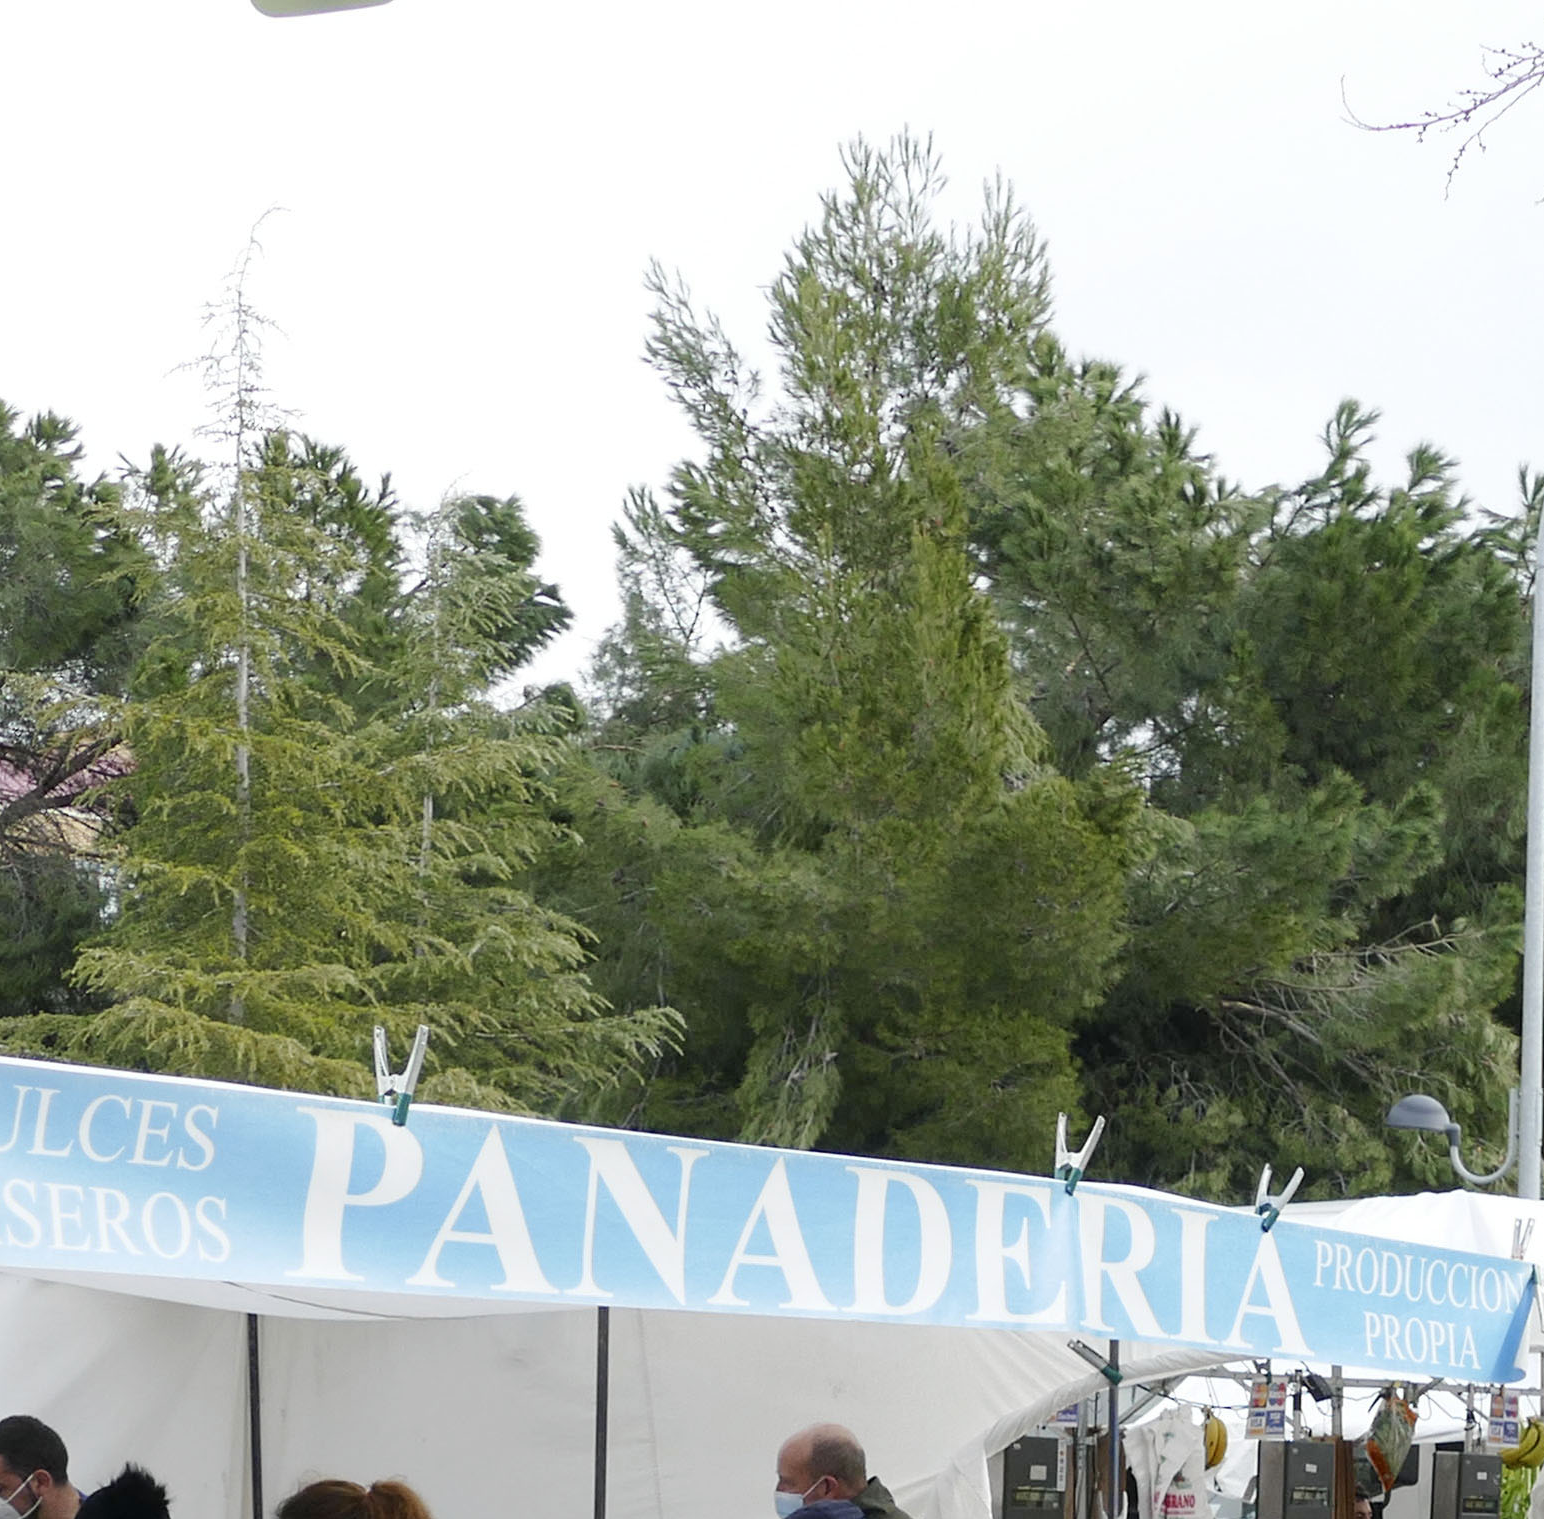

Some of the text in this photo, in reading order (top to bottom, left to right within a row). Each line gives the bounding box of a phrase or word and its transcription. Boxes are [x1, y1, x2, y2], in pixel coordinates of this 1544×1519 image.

[286, 1104, 1314, 1358] PANADERIA
[1313, 1240, 1524, 1314] PRODUCCION
[1363, 1311, 1482, 1370] PROPIA
